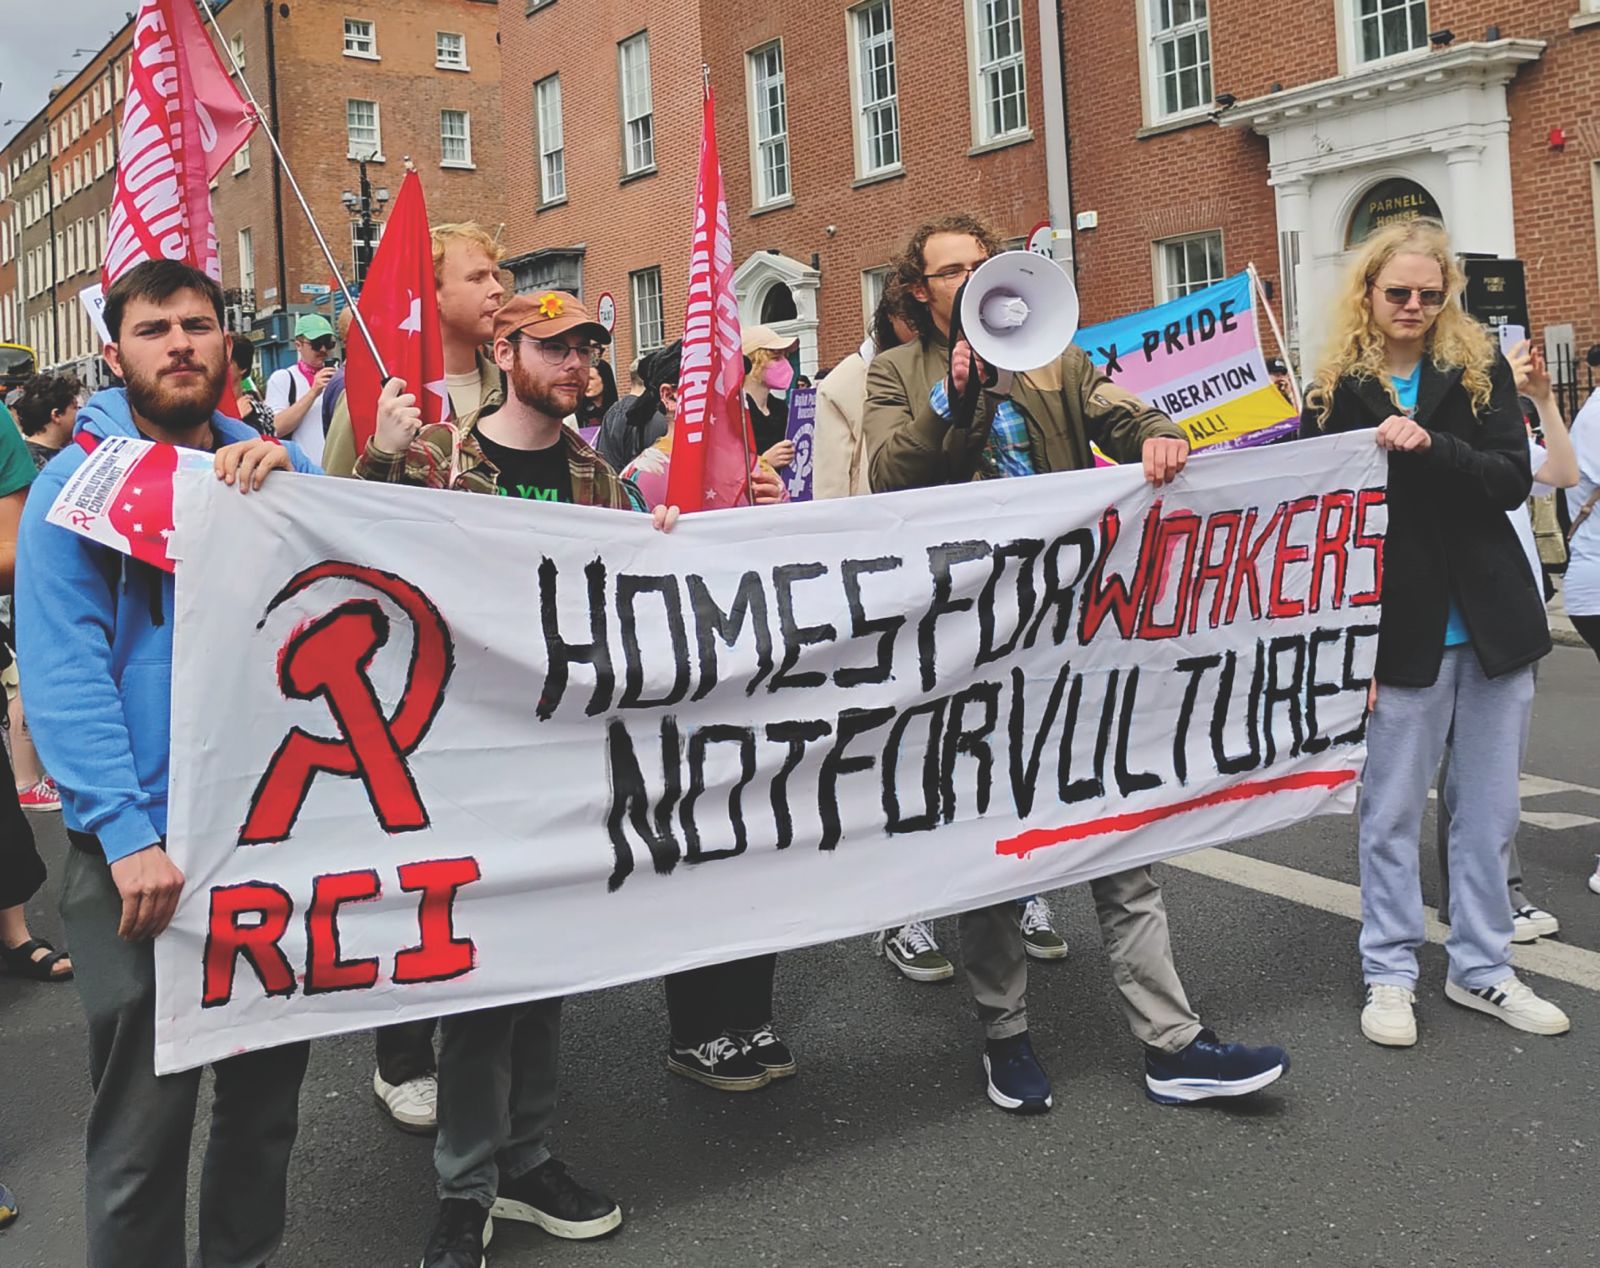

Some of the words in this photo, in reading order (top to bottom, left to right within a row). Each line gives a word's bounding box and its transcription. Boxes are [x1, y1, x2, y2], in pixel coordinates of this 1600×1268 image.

[1369, 193, 1426, 213] PARNELL
[1376, 210, 1419, 227] HOUSE
[1142, 300, 1238, 363] PRIDE
[1188, 414, 1229, 442] ALL!
[75, 455, 120, 509] REVOLUTIONARY
[88, 466, 125, 514] COMMUNIST
[536, 553, 907, 721] HOMES
[918, 528, 1095, 692] FOR
[1079, 486, 1386, 646] WORKERS
[606, 715, 832, 892] NOT
[818, 682, 1002, 851] FOR
[1008, 624, 1379, 819] VULTURES
[202, 856, 481, 1008] RCI
